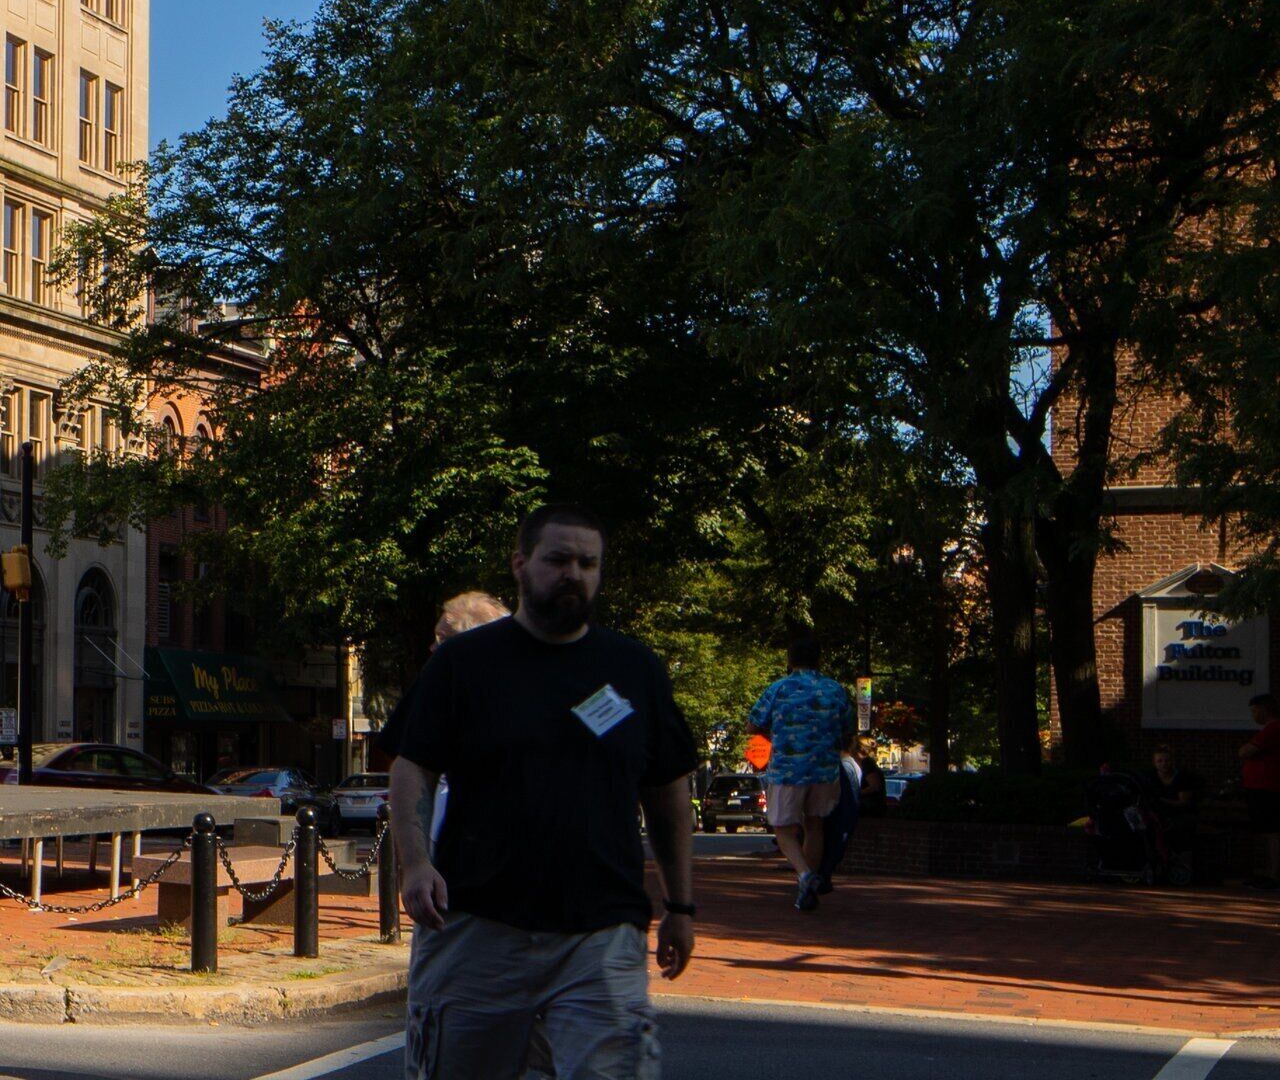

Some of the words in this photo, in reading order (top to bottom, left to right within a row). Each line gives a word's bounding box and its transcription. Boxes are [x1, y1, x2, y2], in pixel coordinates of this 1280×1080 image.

[1181, 621, 1227, 638] The
[1170, 643, 1241, 660] Fulton
[192, 662, 220, 699] My
[1157, 665, 1254, 686] Building
[148, 707, 177, 717] PIZZA
